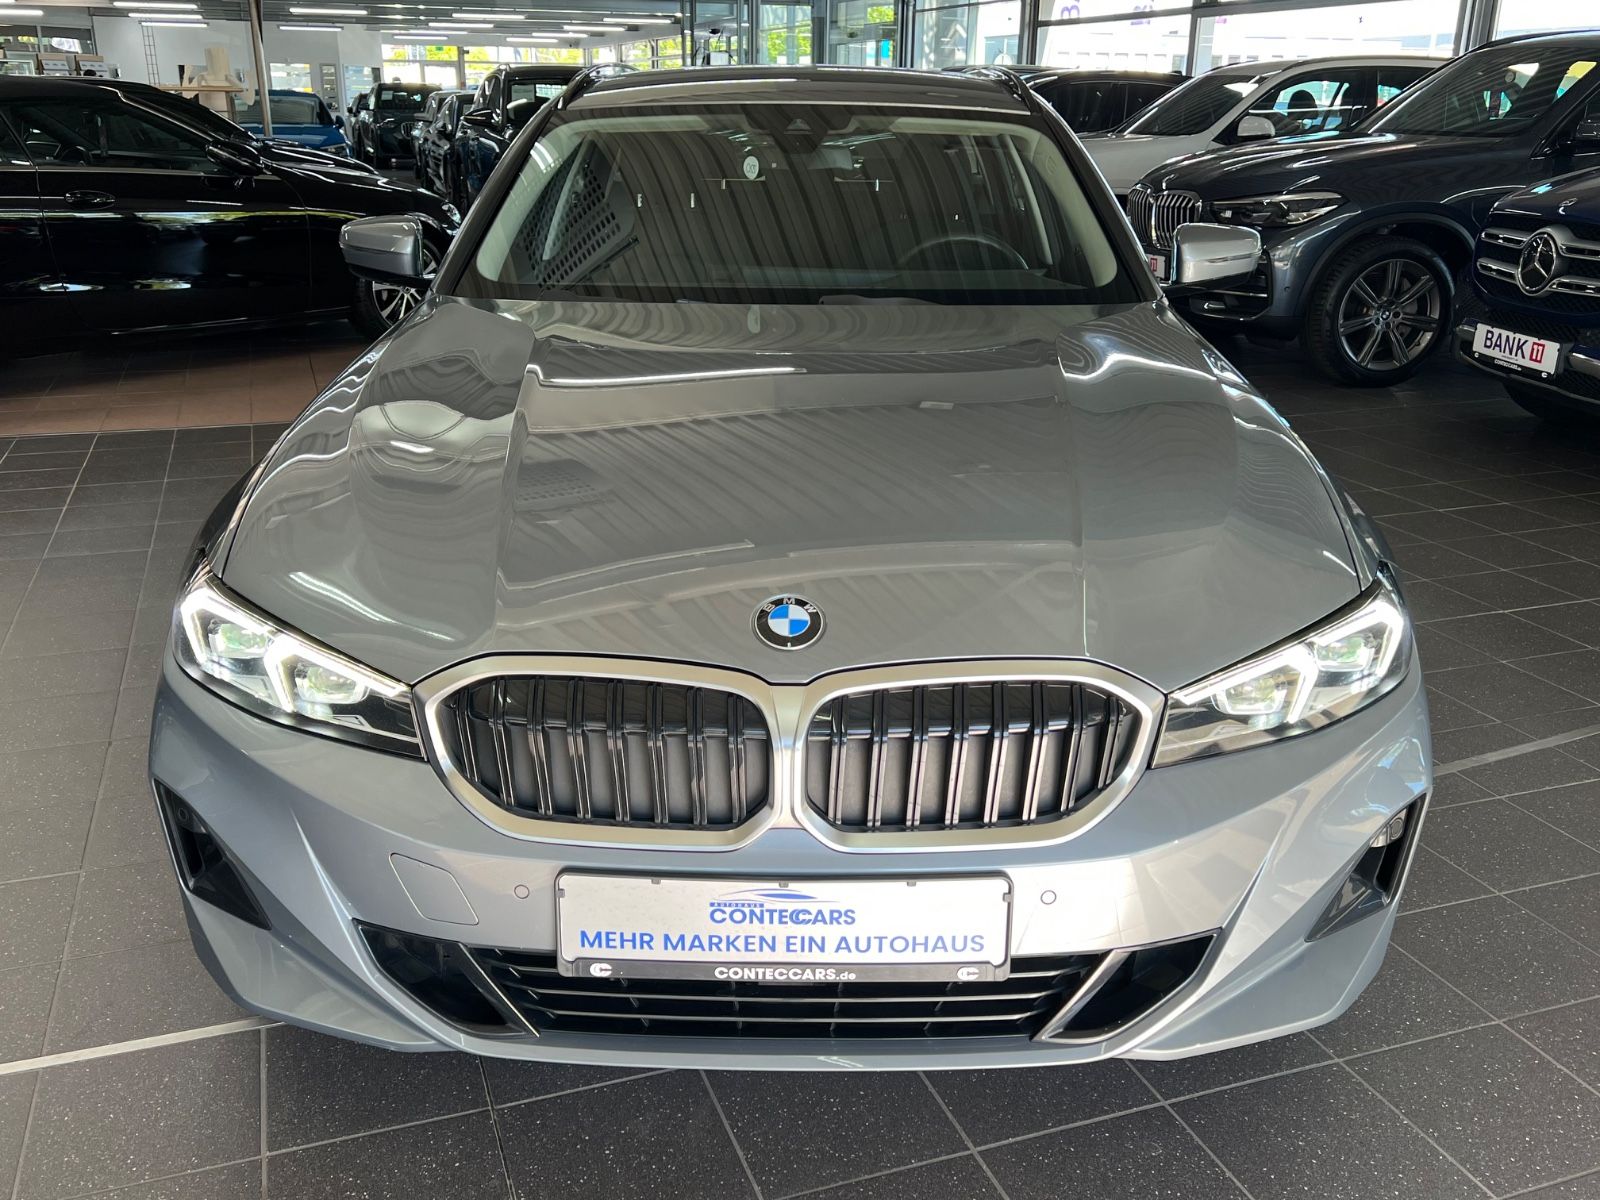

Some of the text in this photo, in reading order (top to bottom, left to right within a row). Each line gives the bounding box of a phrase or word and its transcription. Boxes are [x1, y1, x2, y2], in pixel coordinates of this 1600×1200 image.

[1483, 329, 1528, 359] BANK
[763, 598, 817, 613] BMW
[709, 908, 856, 926] CONTECCARS
[580, 930, 985, 953] MEHR MARKEN EIN AUTOHAUS
[714, 966, 857, 980] CONTECCARS.de
